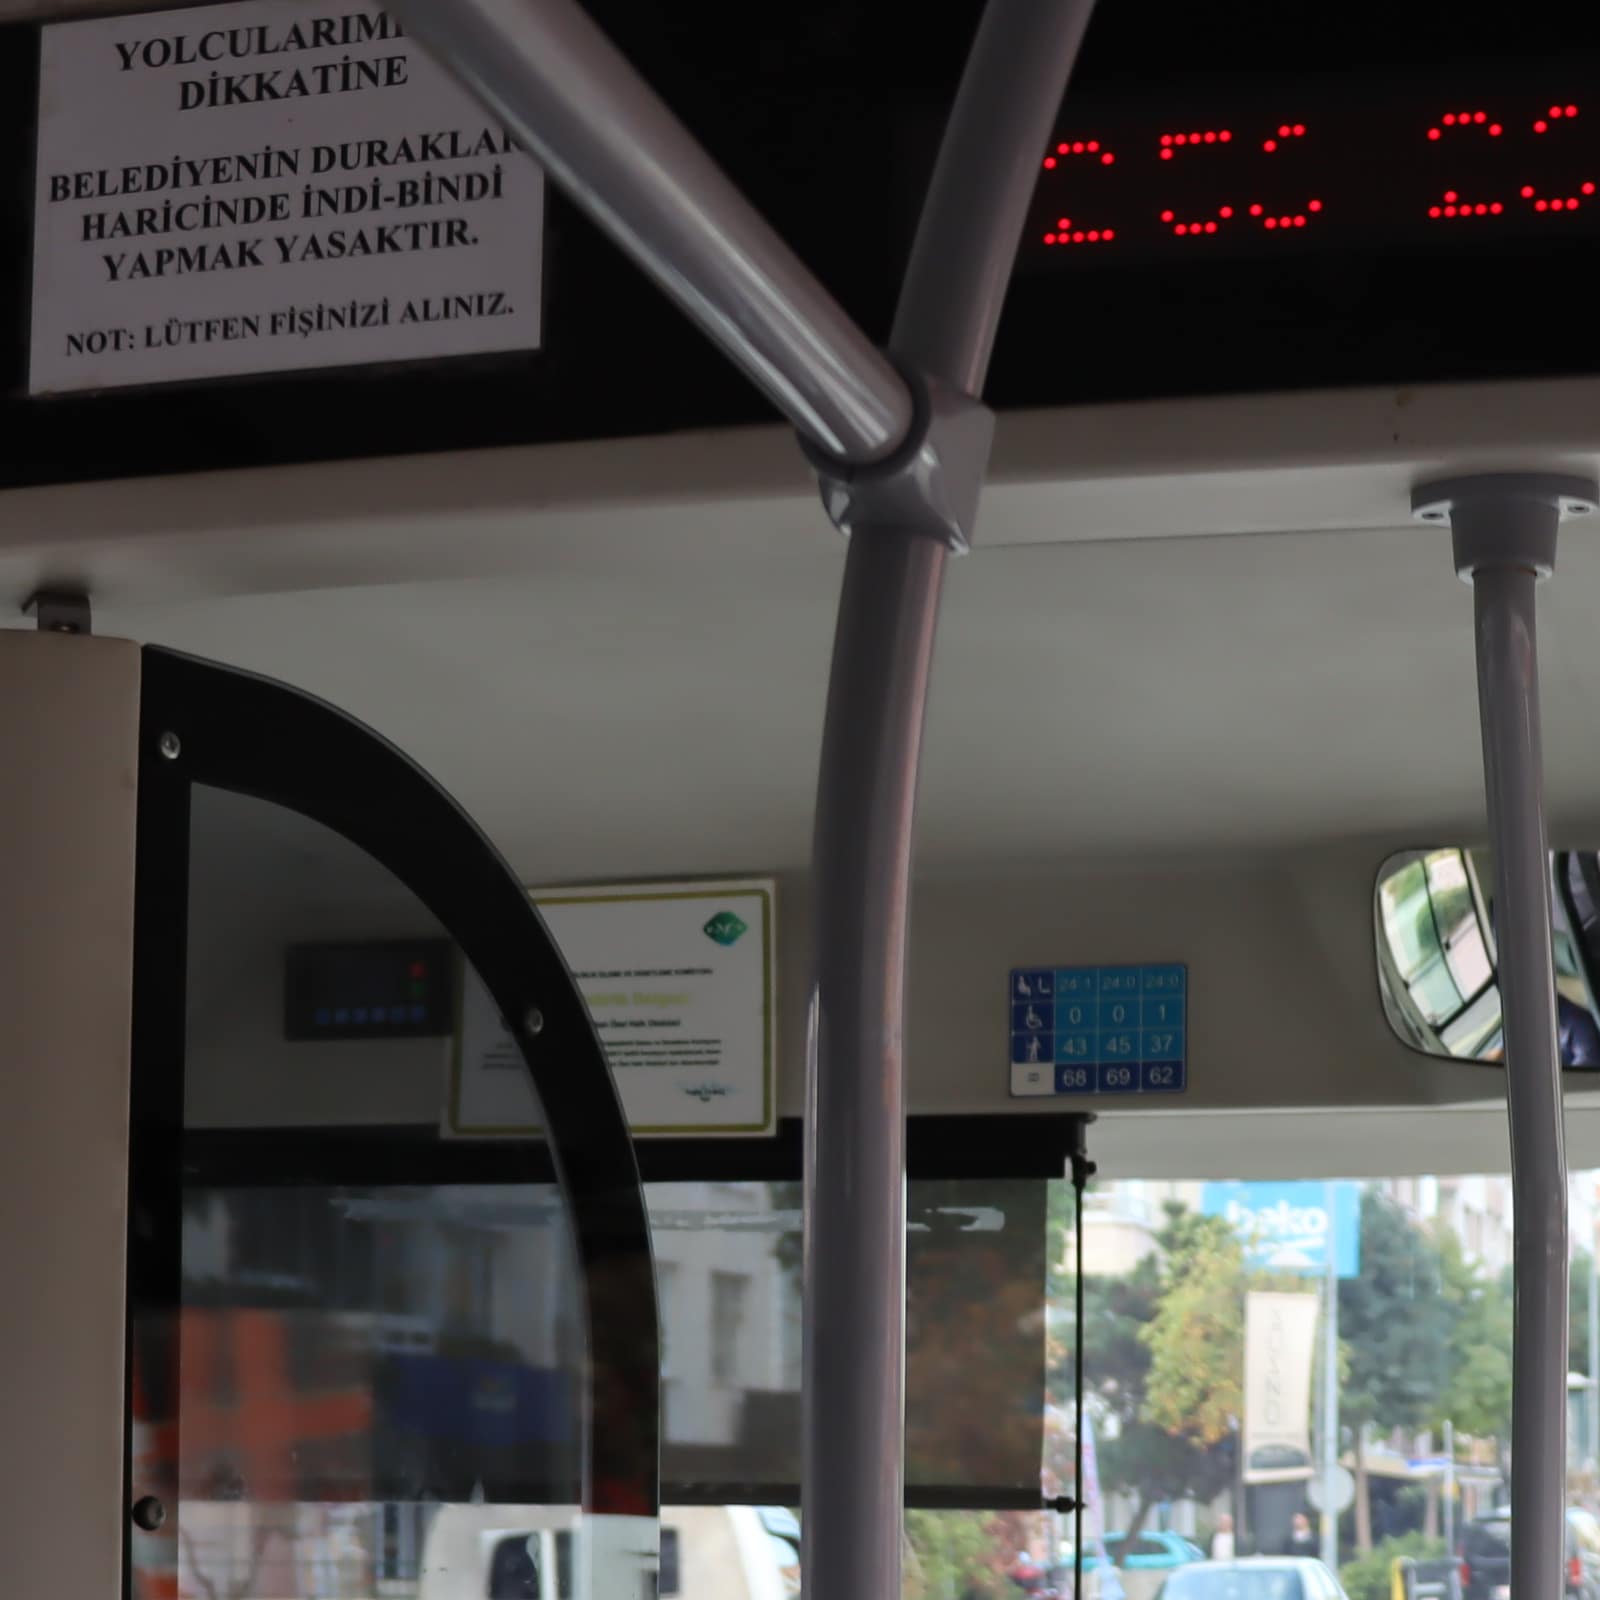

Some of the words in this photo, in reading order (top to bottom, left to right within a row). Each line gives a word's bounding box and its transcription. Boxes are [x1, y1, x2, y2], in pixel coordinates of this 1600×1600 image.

[179, 55, 409, 111] DİKKATİNE
[49, 145, 301, 203] BELEDİYENİN
[80, 193, 291, 242] HARİCİNDE
[300, 163, 504, 219] İNDİ-BİNDİ
[102, 239, 264, 283] YAPMAK
[274, 217, 479, 265] YASAKTIR.
[65, 328, 135, 357] NOT:
[144, 314, 260, 349] LÜTFEN
[268, 296, 390, 338] FİŞİNİZİ
[399, 291, 514, 325] ALINIZ.
[1063, 1037, 1087, 1056] 43
[1106, 1035, 1131, 1054] 45
[1151, 1034, 1173, 1053] 37
[1062, 1068, 1087, 1088] 68
[1106, 1067, 1130, 1086] 69
[1149, 1066, 1173, 1085] 62
[1226, 1199, 1329, 1236] beko
